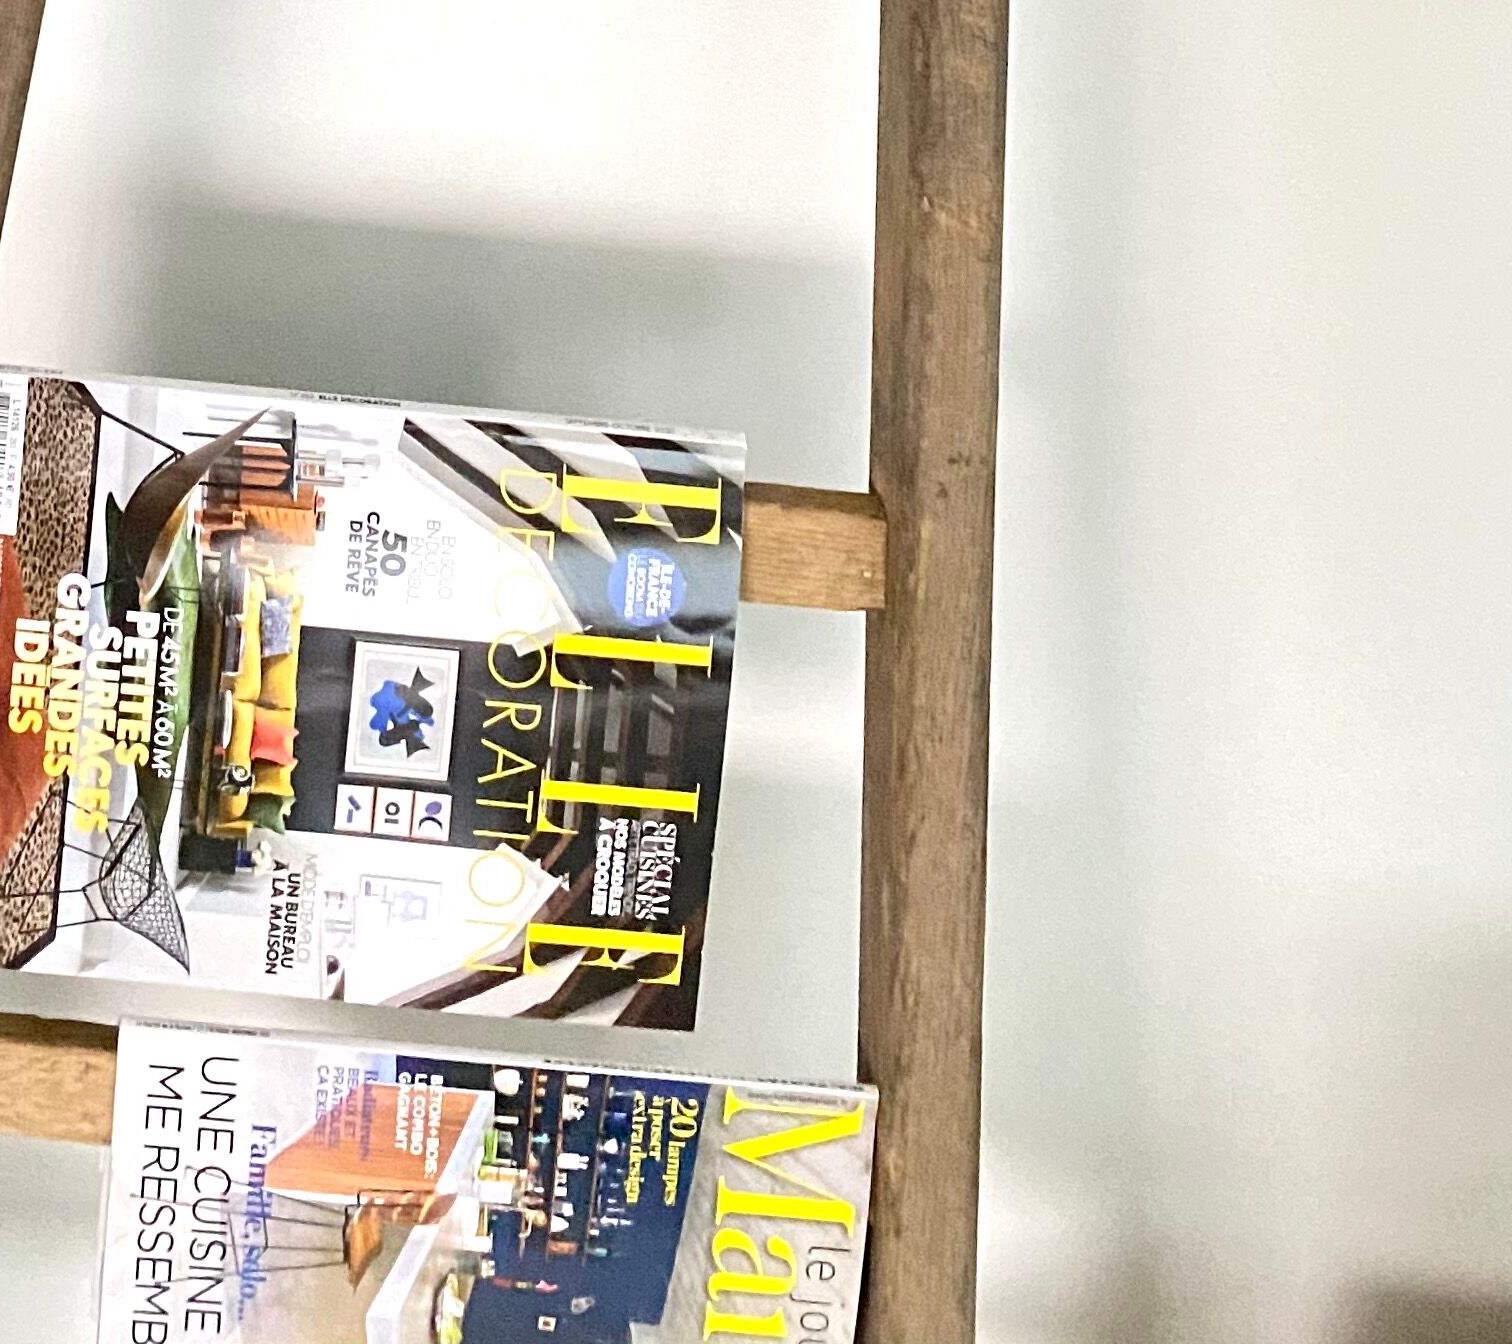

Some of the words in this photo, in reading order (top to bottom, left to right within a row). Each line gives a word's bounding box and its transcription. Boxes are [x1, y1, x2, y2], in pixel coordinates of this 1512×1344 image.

[348, 520, 363, 543] DE
[361, 511, 381, 597] CANAPÉS
[379, 529, 408, 577] 50
[345, 548, 362, 593] RÊVE
[645, 558, 662, 618] FRANCE
[160, 635, 181, 665] 45
[163, 607, 184, 634] DE
[8, 616, 51, 735] IDÉES
[43, 572, 92, 779] GRANDES
[115, 610, 161, 768] PETITES
[73, 626, 124, 834] SURFACES
[153, 717, 175, 746] 60
[462, 468, 558, 974] DECORATION
[522, 464, 722, 986] ELLE
[614, 817, 630, 850] NOS
[271, 877, 286, 898] LA
[286, 873, 301, 898] UN
[590, 833, 613, 916] CROQUER
[634, 820, 661, 921] CUISINES
[650, 822, 681, 915] SPÉCIAL
[264, 904, 284, 975] MAISON
[280, 902, 299, 969] BUREAU
[144, 1064, 185, 1133] ME
[196, 1055, 240, 1154] UNE
[329, 1066, 345, 1150] PRATIQUES
[346, 1067, 360, 1117] BEAUX
[394, 1071, 412, 1152] GAGNANT
[414, 1073, 429, 1092] LE
[344, 1120, 357, 1136] ET
[409, 1095, 426, 1156] COMBO
[630, 1091, 648, 1145] extra
[647, 1108, 664, 1162] poser
[669, 1096, 700, 1139] 20
[624, 1145, 648, 1204] design
[662, 1140, 686, 1207] lampes
[131, 1144, 181, 1344] RESSEMB
[184, 1165, 232, 1334] CUISINE
[805, 1244, 853, 1283] le
[790, 1292, 846, 1344] jo
